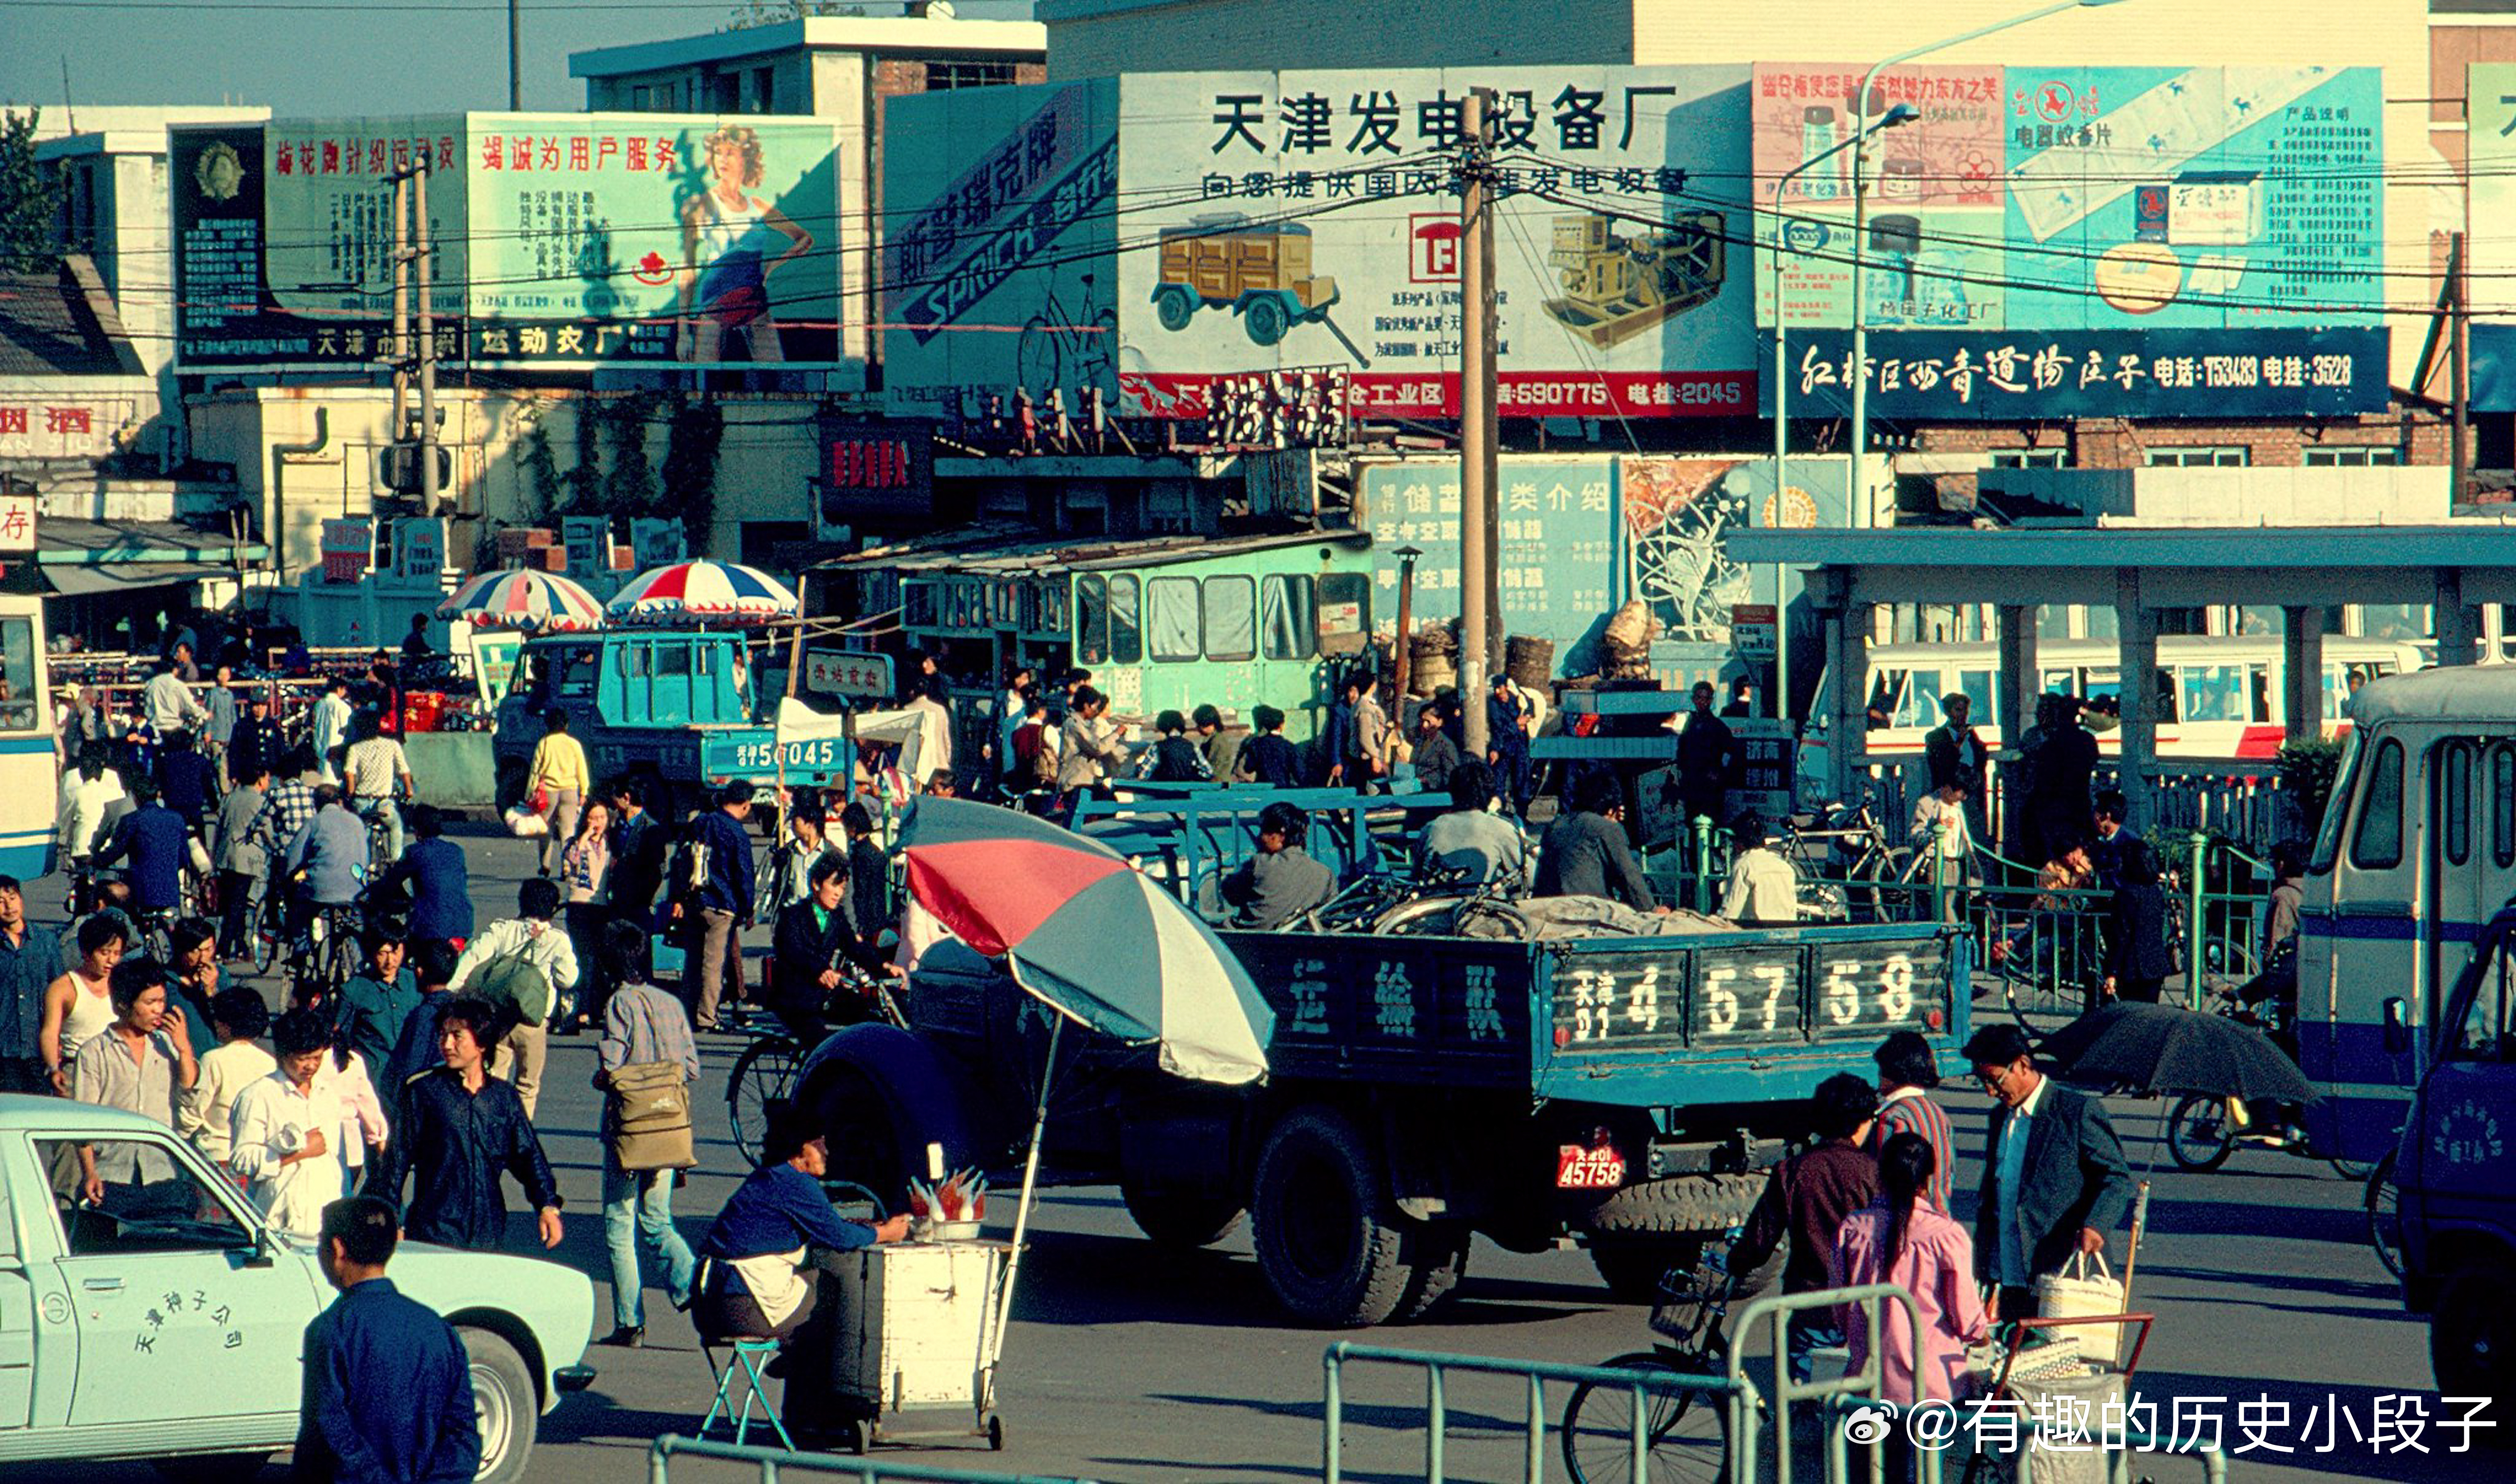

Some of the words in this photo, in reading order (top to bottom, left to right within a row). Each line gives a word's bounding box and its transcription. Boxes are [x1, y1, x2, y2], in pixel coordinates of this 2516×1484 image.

[1211, 83, 1676, 155] 天津发电设备厂
[2286, 106, 2349, 121] 产品说明
[482, 136, 677, 172] 竭诚为用户服务
[317, 326, 457, 359] 天津市织
[482, 325, 622, 354] 运动衣厂
[2263, 355, 2352, 387] 电挂:3528
[1627, 381, 1742, 405] 电挂:2045
[1403, 482, 1608, 513] 储蓄类介绍
[1627, 955, 1914, 1035] 45758
[1560, 1162, 1622, 1186] 45758
